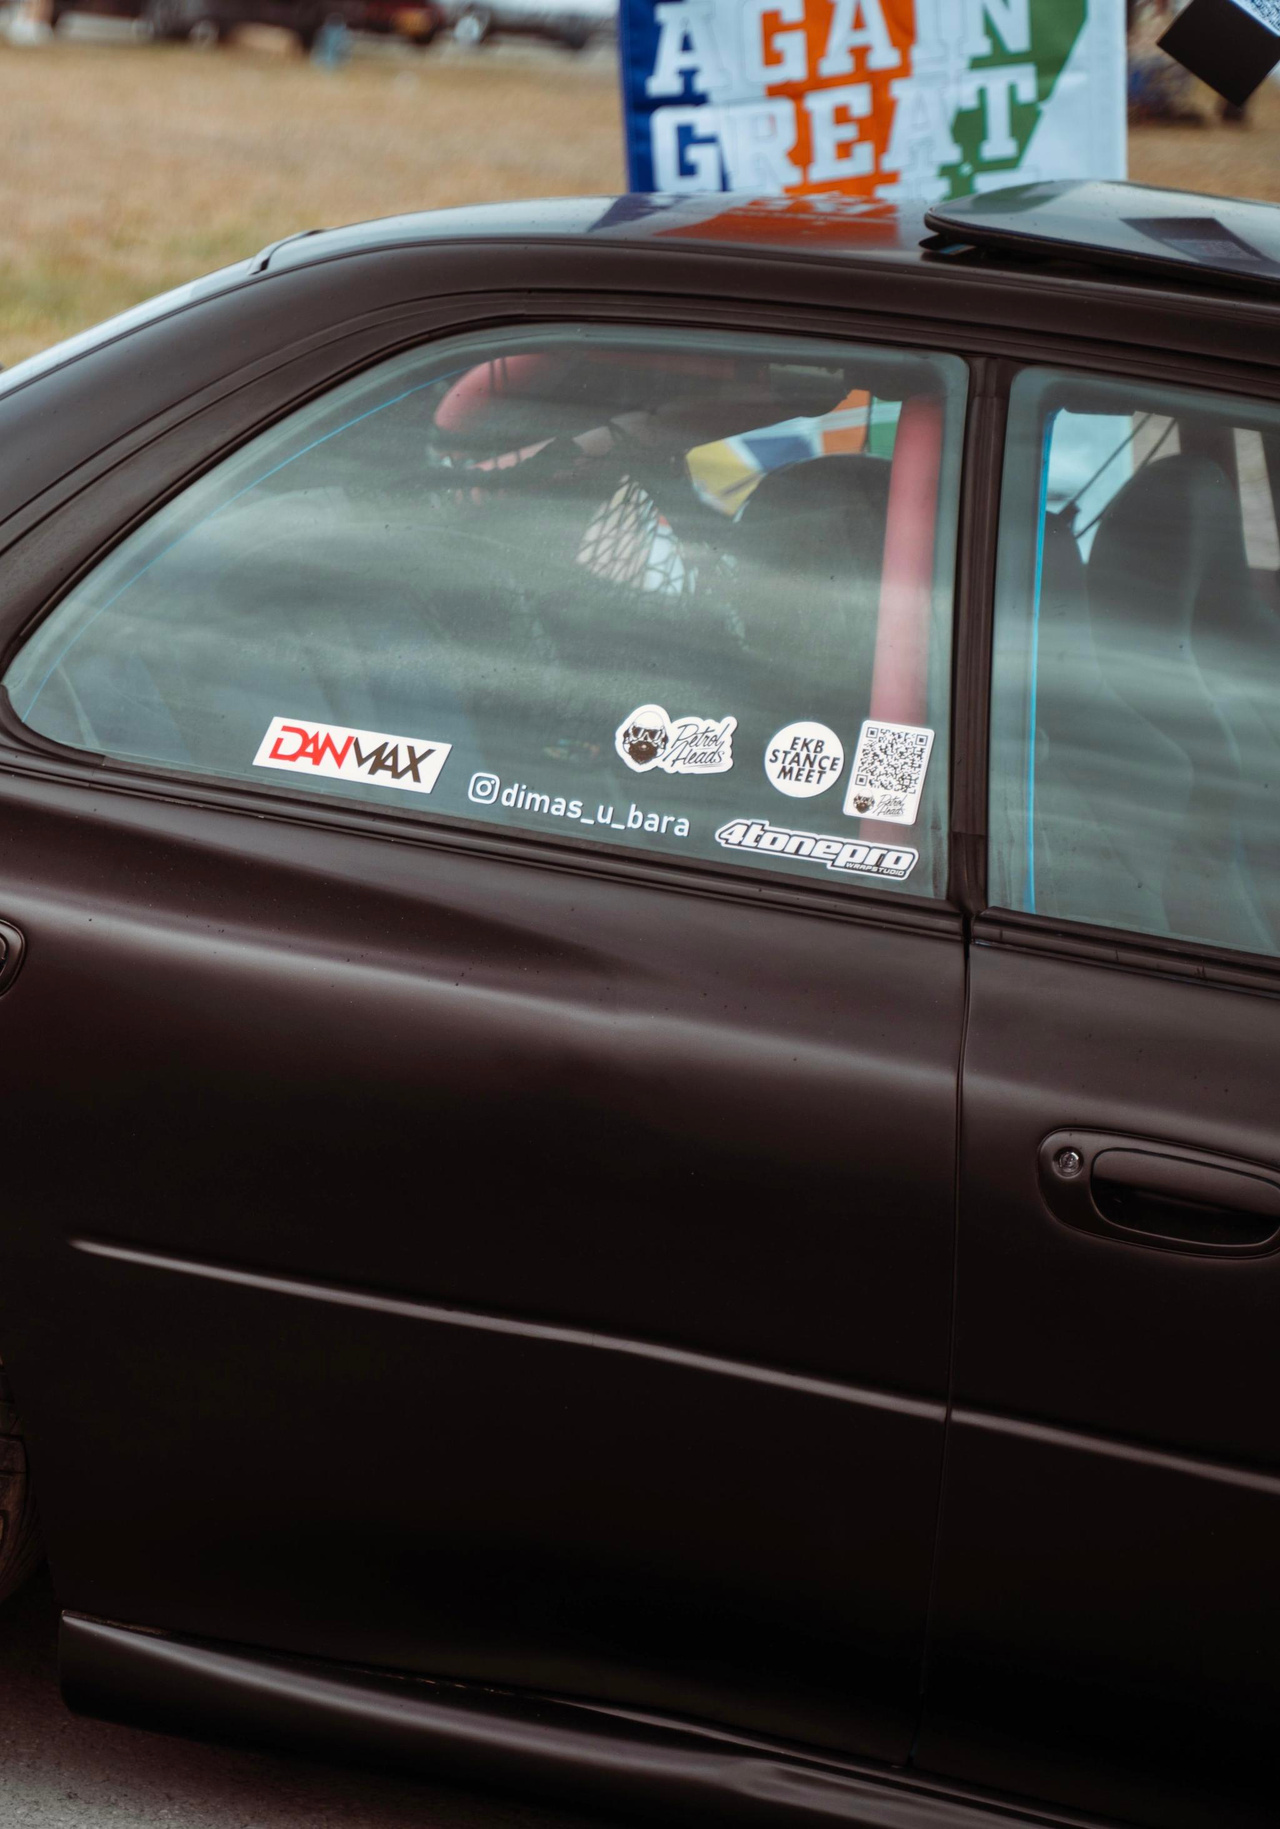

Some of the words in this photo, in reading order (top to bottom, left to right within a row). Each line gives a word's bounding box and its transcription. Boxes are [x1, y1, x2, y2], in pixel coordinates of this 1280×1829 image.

[645, 0, 1033, 98] AGAIN
[650, 62, 1039, 192] GREAT
[671, 723, 730, 748] Petrol
[790, 736, 825, 754] EKB
[269, 725, 436, 783] DANMAX
[662, 741, 725, 767] Heads
[769, 748, 841, 772] STANCE
[777, 765, 827, 785] MEET
[501, 783, 690, 837] dimas_u_bara
[720, 822, 915, 867] 4tonepro
[845, 861, 905, 877] WRAPSTUDIO
